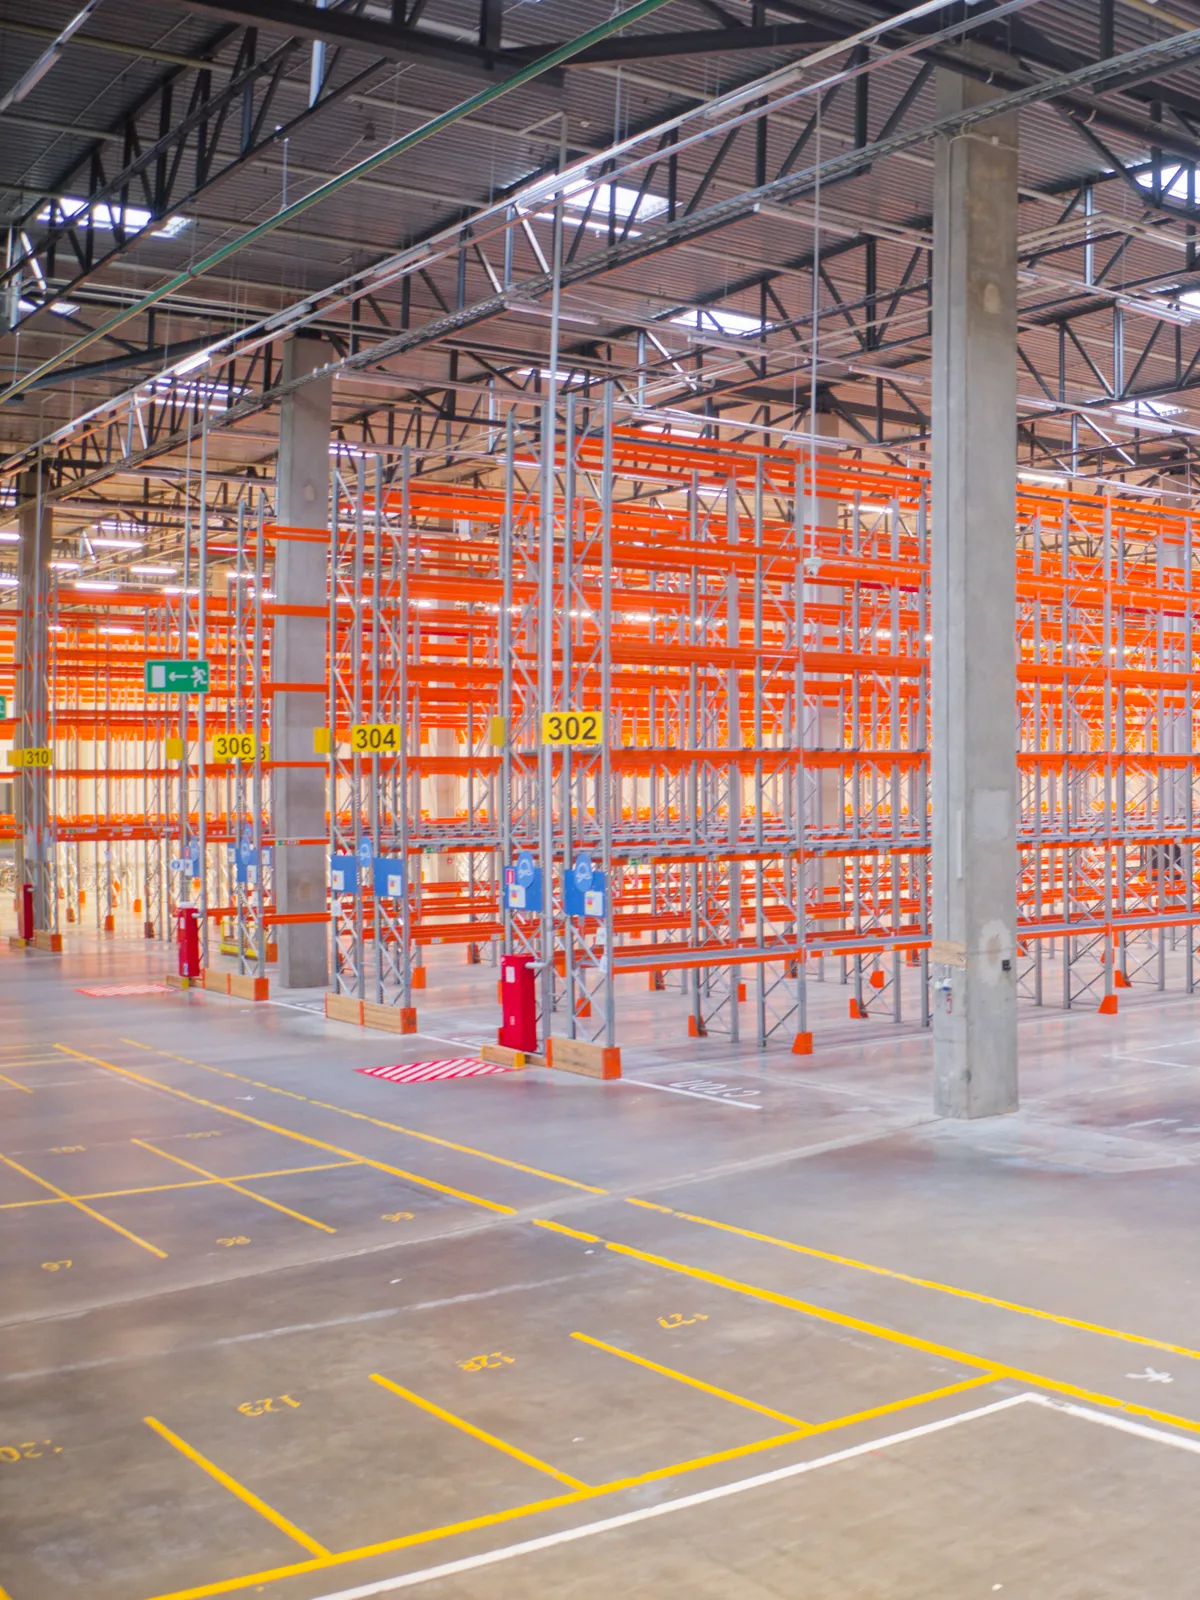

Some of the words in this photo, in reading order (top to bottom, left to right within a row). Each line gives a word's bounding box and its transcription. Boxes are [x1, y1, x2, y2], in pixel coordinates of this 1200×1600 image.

[549, 716, 596, 740] 302
[217, 737, 252, 755] 306
[356, 728, 396, 749] 304
[26, 751, 49, 765] 310
